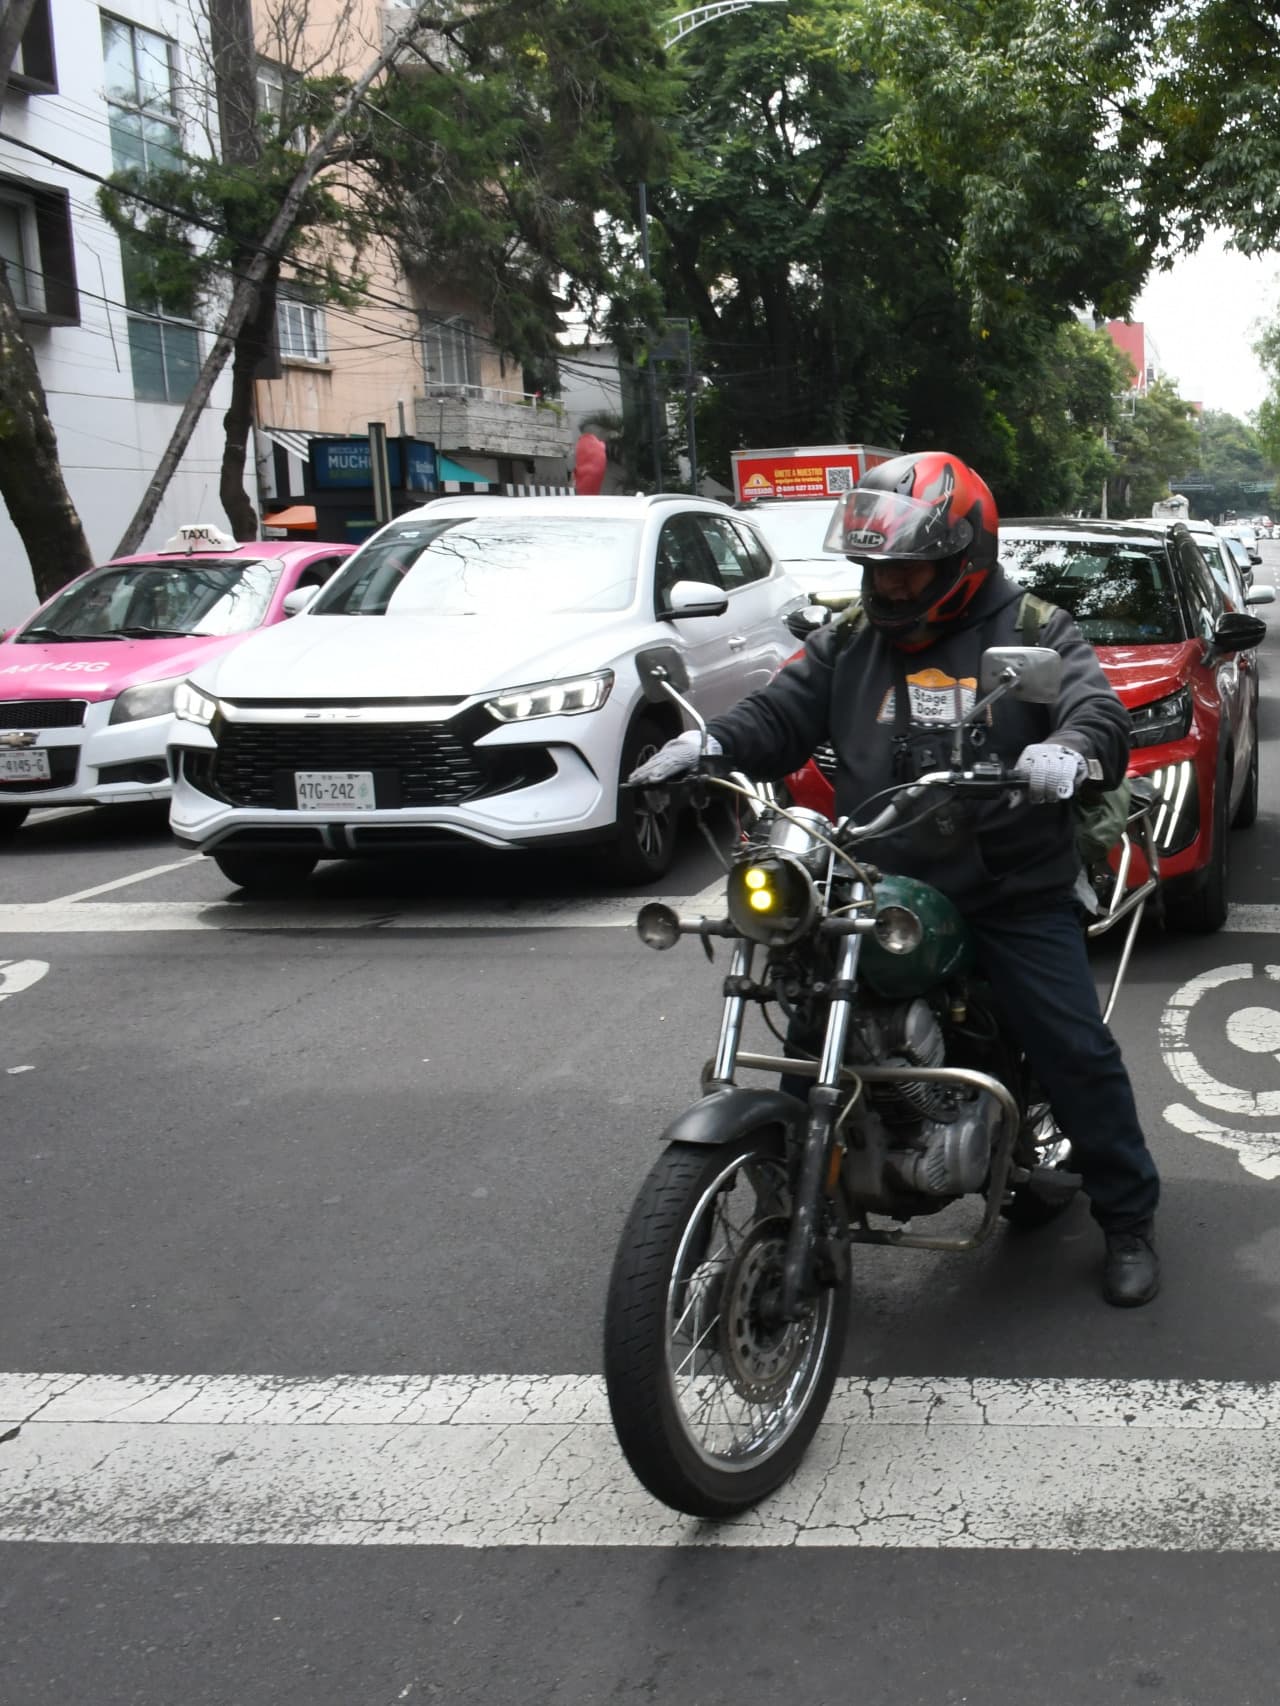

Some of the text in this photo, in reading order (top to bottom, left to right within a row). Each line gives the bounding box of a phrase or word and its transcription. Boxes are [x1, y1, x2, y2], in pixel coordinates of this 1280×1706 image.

[328, 455, 371, 469] MUCH
[181, 528, 209, 540] TAXI
[849, 532, 881, 545] HJC
[913, 688, 947, 707] Stage
[917, 702, 943, 716] Door
[299, 783, 355, 799] 47G-242
